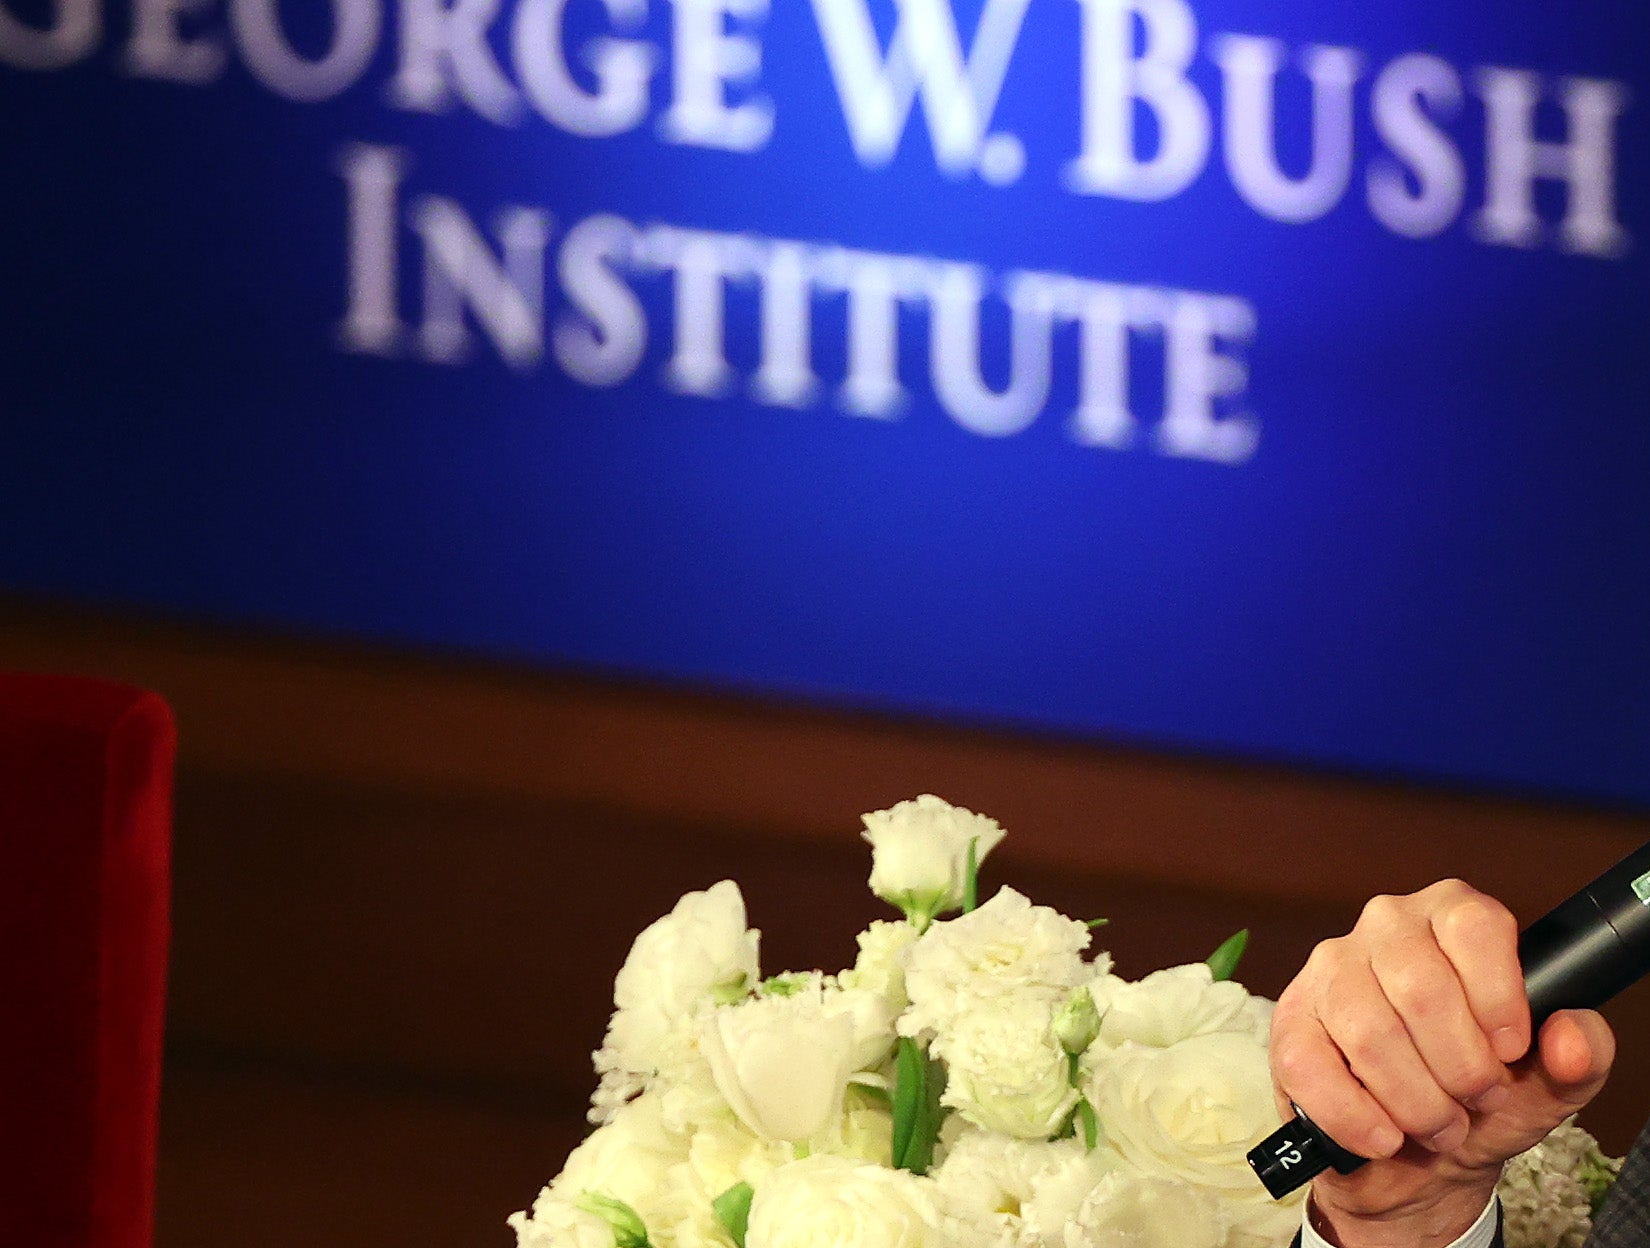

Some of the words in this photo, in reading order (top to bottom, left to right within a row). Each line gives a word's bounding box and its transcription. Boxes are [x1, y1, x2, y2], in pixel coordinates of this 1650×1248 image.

[812, 0, 1025, 186] W.
[1066, 0, 1628, 257] BUSH
[337, 143, 1258, 462] INSTITUTE
[1274, 1140, 1303, 1170] 12
